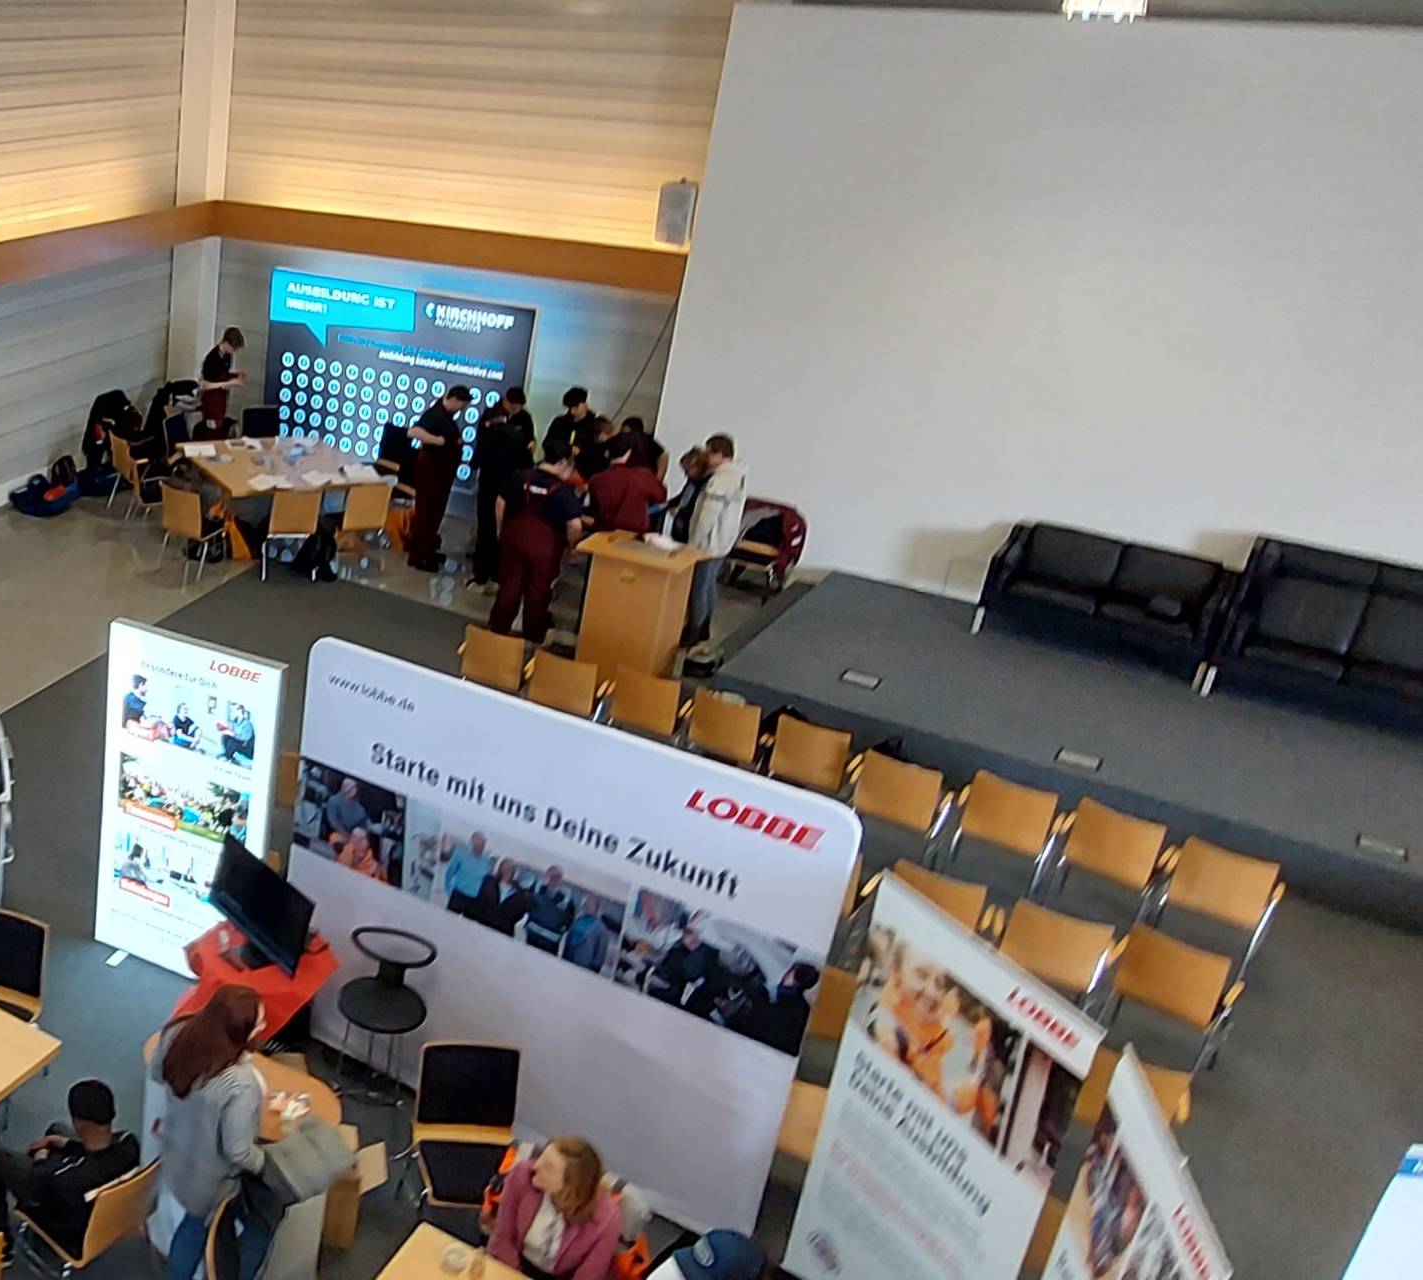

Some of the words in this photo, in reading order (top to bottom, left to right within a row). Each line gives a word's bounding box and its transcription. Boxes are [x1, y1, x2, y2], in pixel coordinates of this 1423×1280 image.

[286, 282, 370, 306] AUSBILDUNG
[373, 296, 396, 310] IST
[436, 303, 515, 331] KIRCHHOFF
[209, 660, 262, 683] LOBBE
[370, 741, 441, 788] Starte
[446, 774, 485, 804] mit
[492, 792, 537, 823] uns
[544, 805, 618, 855] Deine
[626, 836, 741, 900] Zukunft
[683, 787, 827, 851] LOBBE
[1007, 986, 1081, 1049] LOBBE
